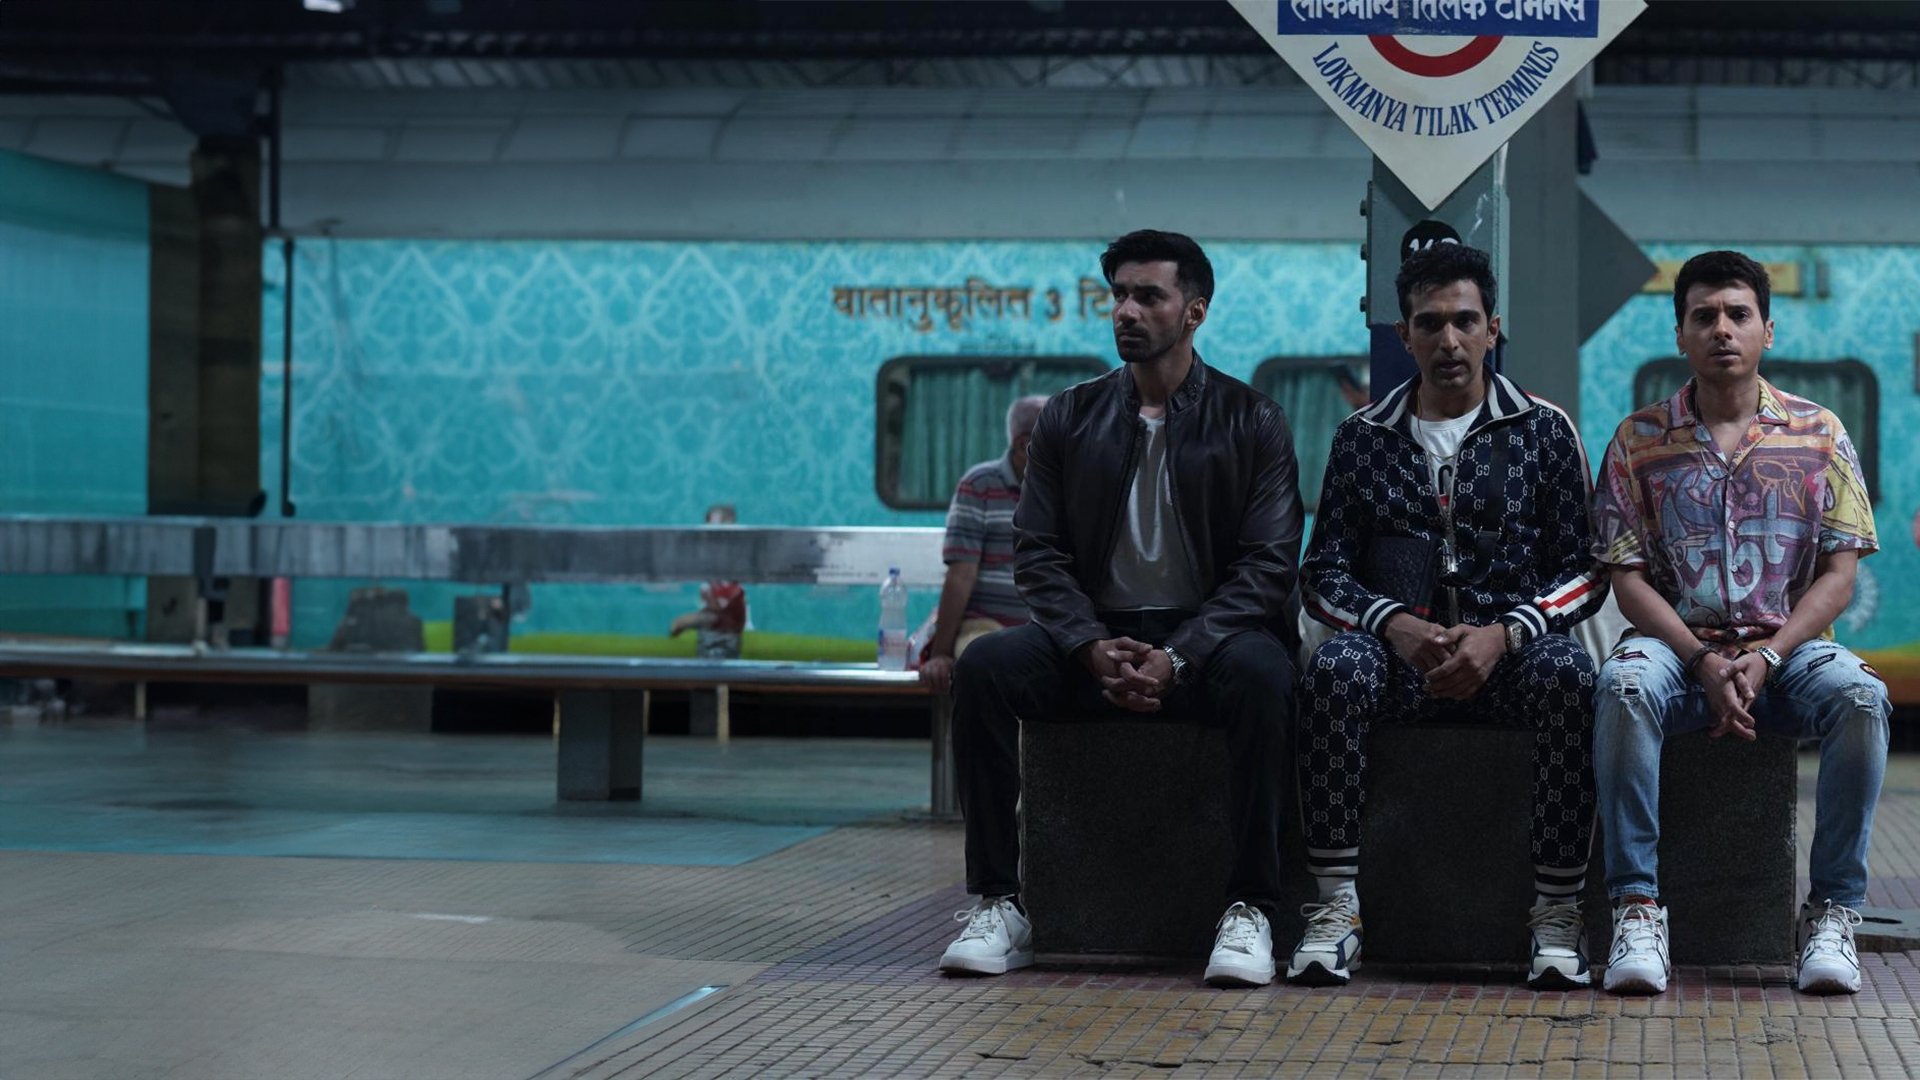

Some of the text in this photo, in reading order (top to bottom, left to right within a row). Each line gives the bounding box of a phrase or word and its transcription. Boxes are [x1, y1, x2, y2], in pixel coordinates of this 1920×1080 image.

[1313, 41, 1559, 137] LOKMANYA TILAK TERMINUS
